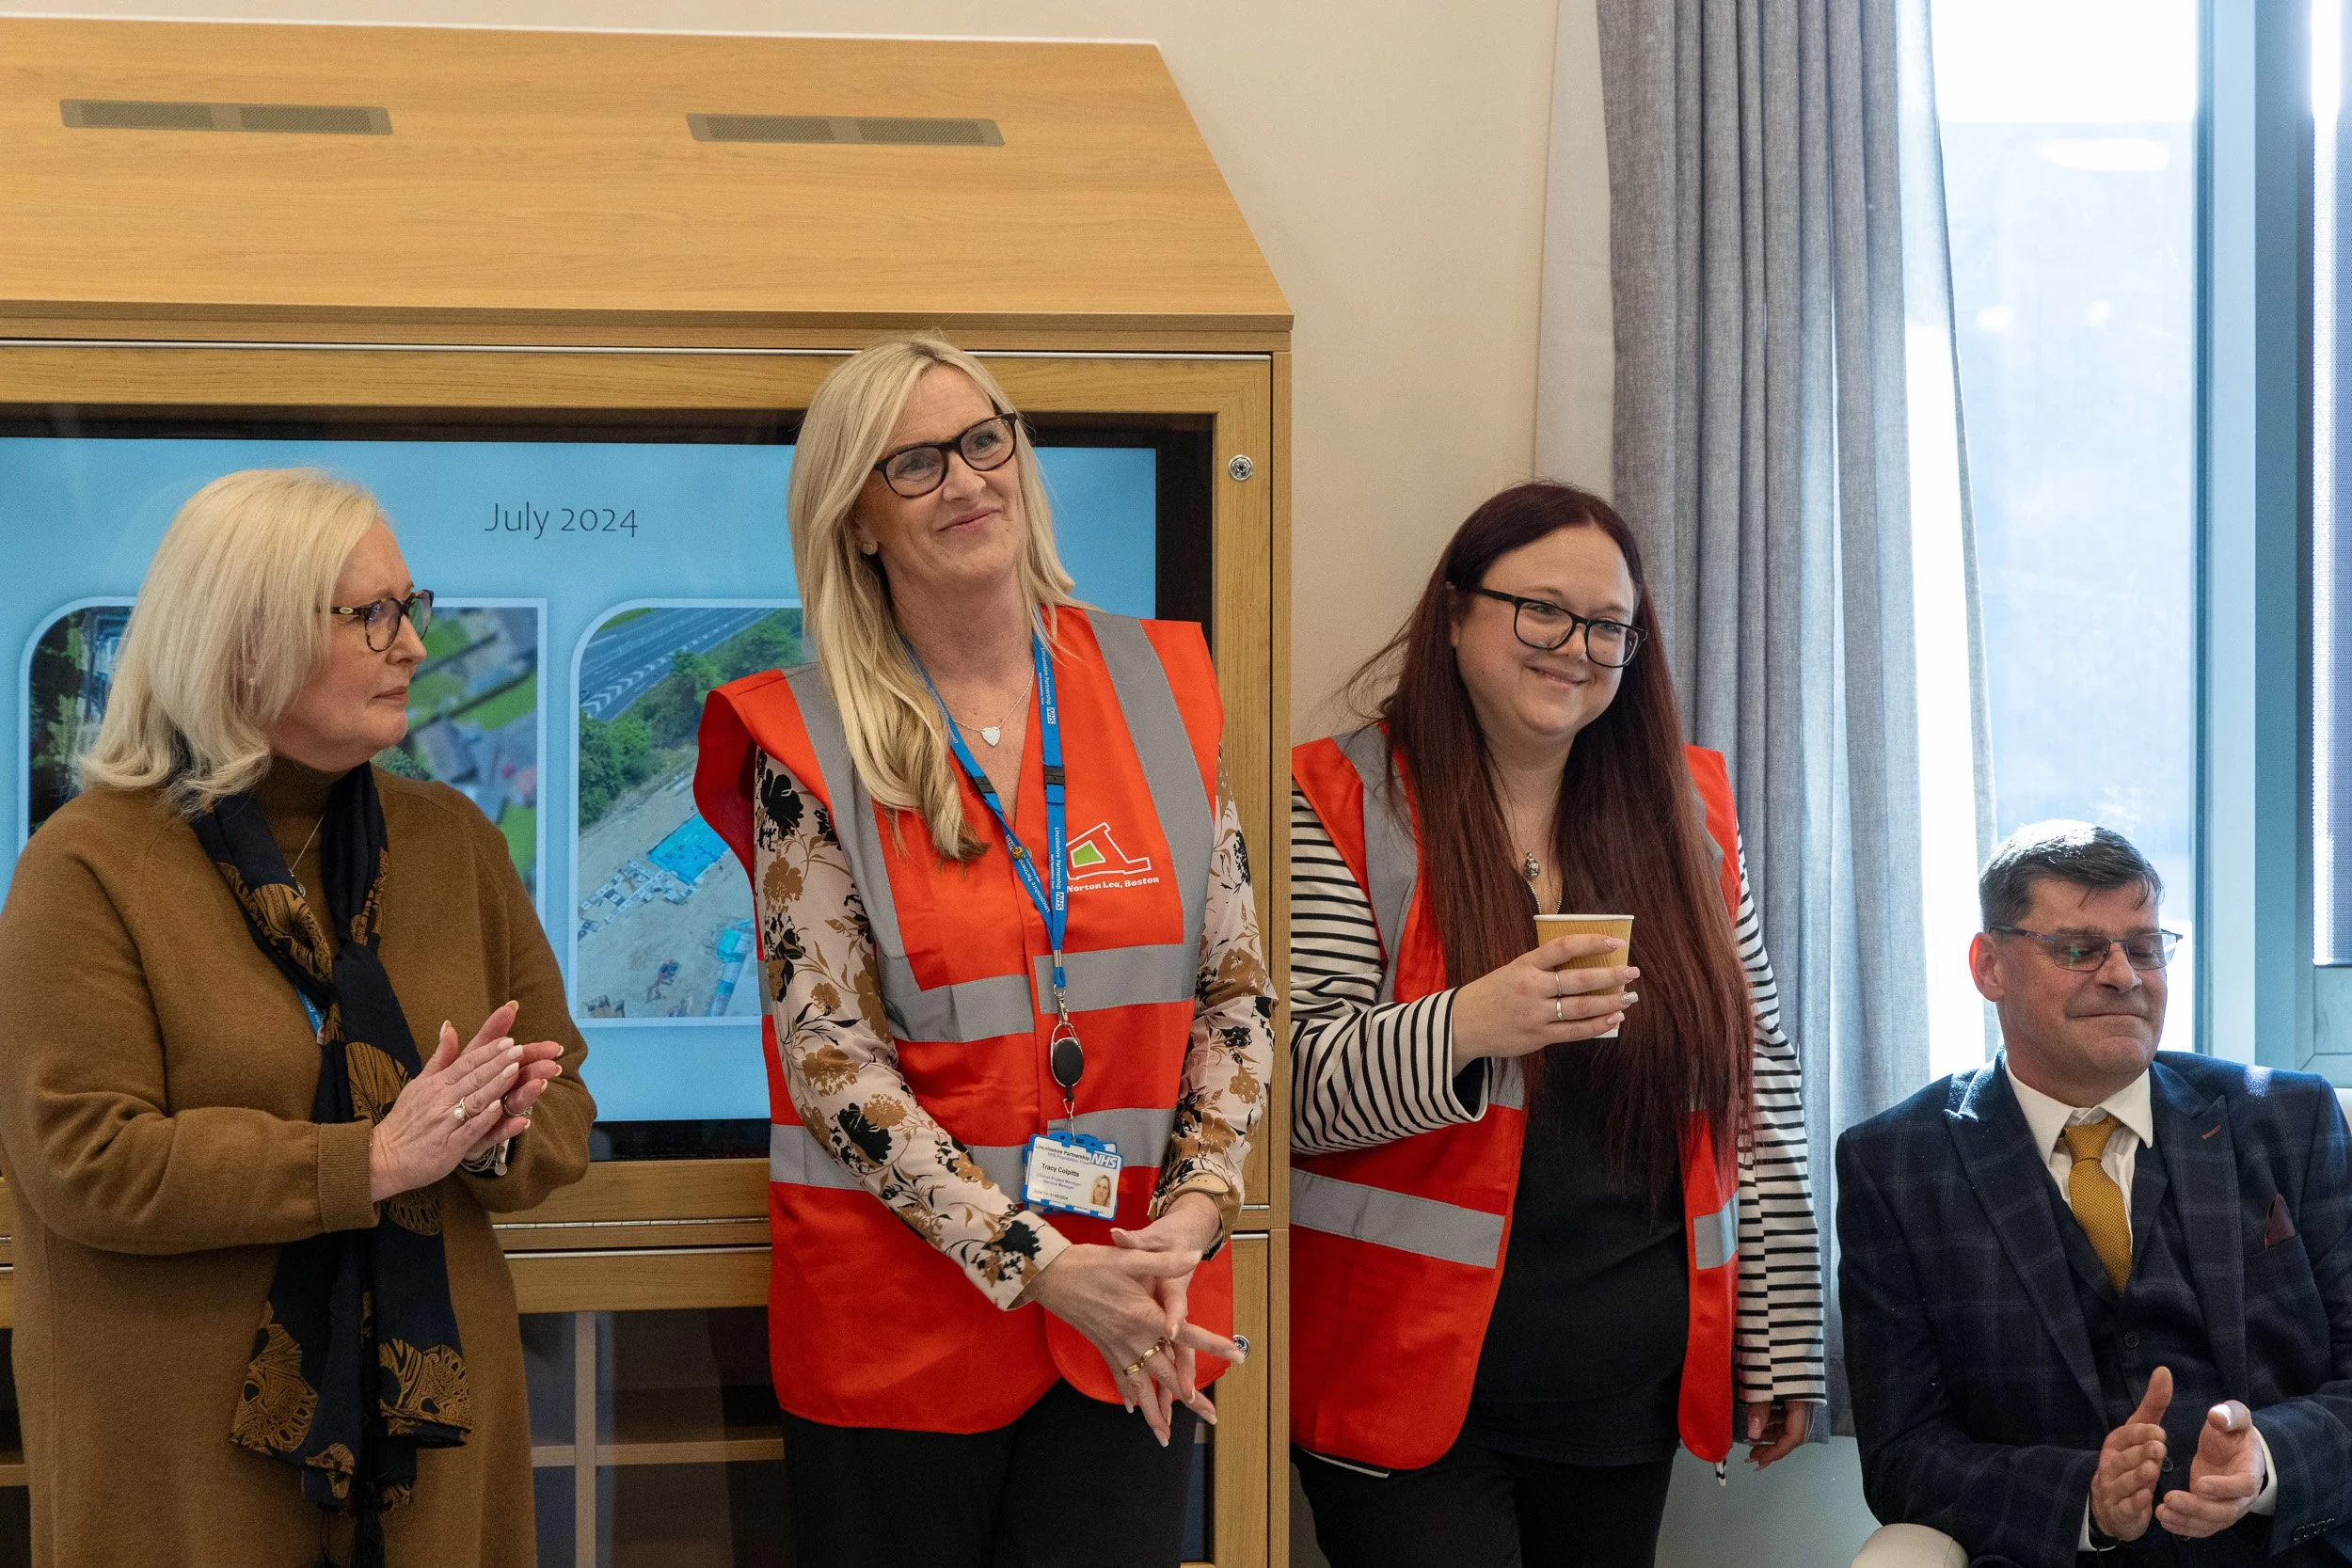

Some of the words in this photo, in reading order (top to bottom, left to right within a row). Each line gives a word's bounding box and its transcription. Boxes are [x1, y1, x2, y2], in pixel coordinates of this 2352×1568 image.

[485, 501, 549, 540] July
[561, 508, 639, 538] 2024
[1047, 707, 1056, 724] NHS
[1066, 882, 1102, 893] Norton
[1103, 880, 1123, 889] Lea,
[1124, 876, 1159, 888] Boston
[1031, 881, 1051, 912] Lincolnshire
[1056, 891, 1064, 911] NHS
[1035, 1143, 1063, 1154] Lincolnshire
[1063, 1150, 1090, 1162] Partnership
[1090, 1153, 1118, 1169] NHS
[1041, 1163, 1057, 1173] Tracy
[1057, 1166, 1080, 1178] Colpitts
